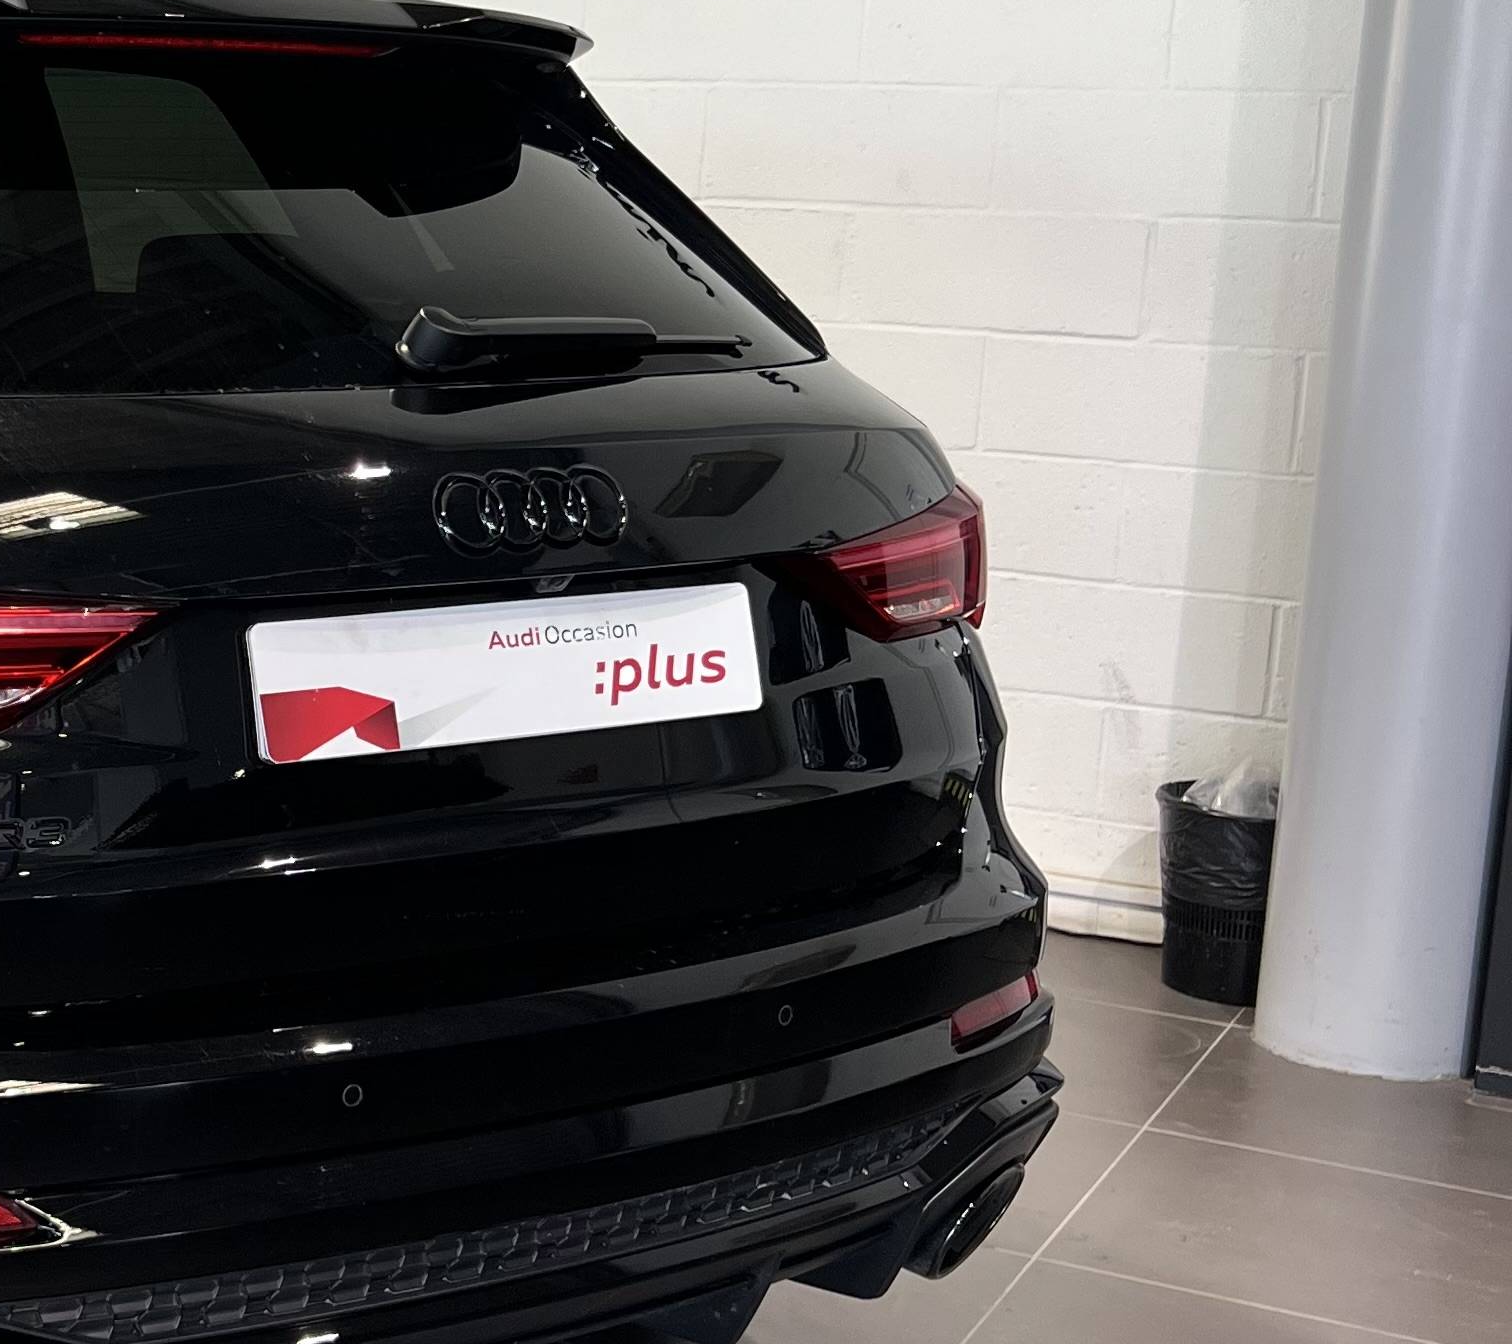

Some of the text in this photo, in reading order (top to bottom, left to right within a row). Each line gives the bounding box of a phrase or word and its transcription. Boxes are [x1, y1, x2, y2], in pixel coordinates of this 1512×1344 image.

[488, 619, 638, 650] Audi Occasion
[594, 643, 727, 706] :plus
